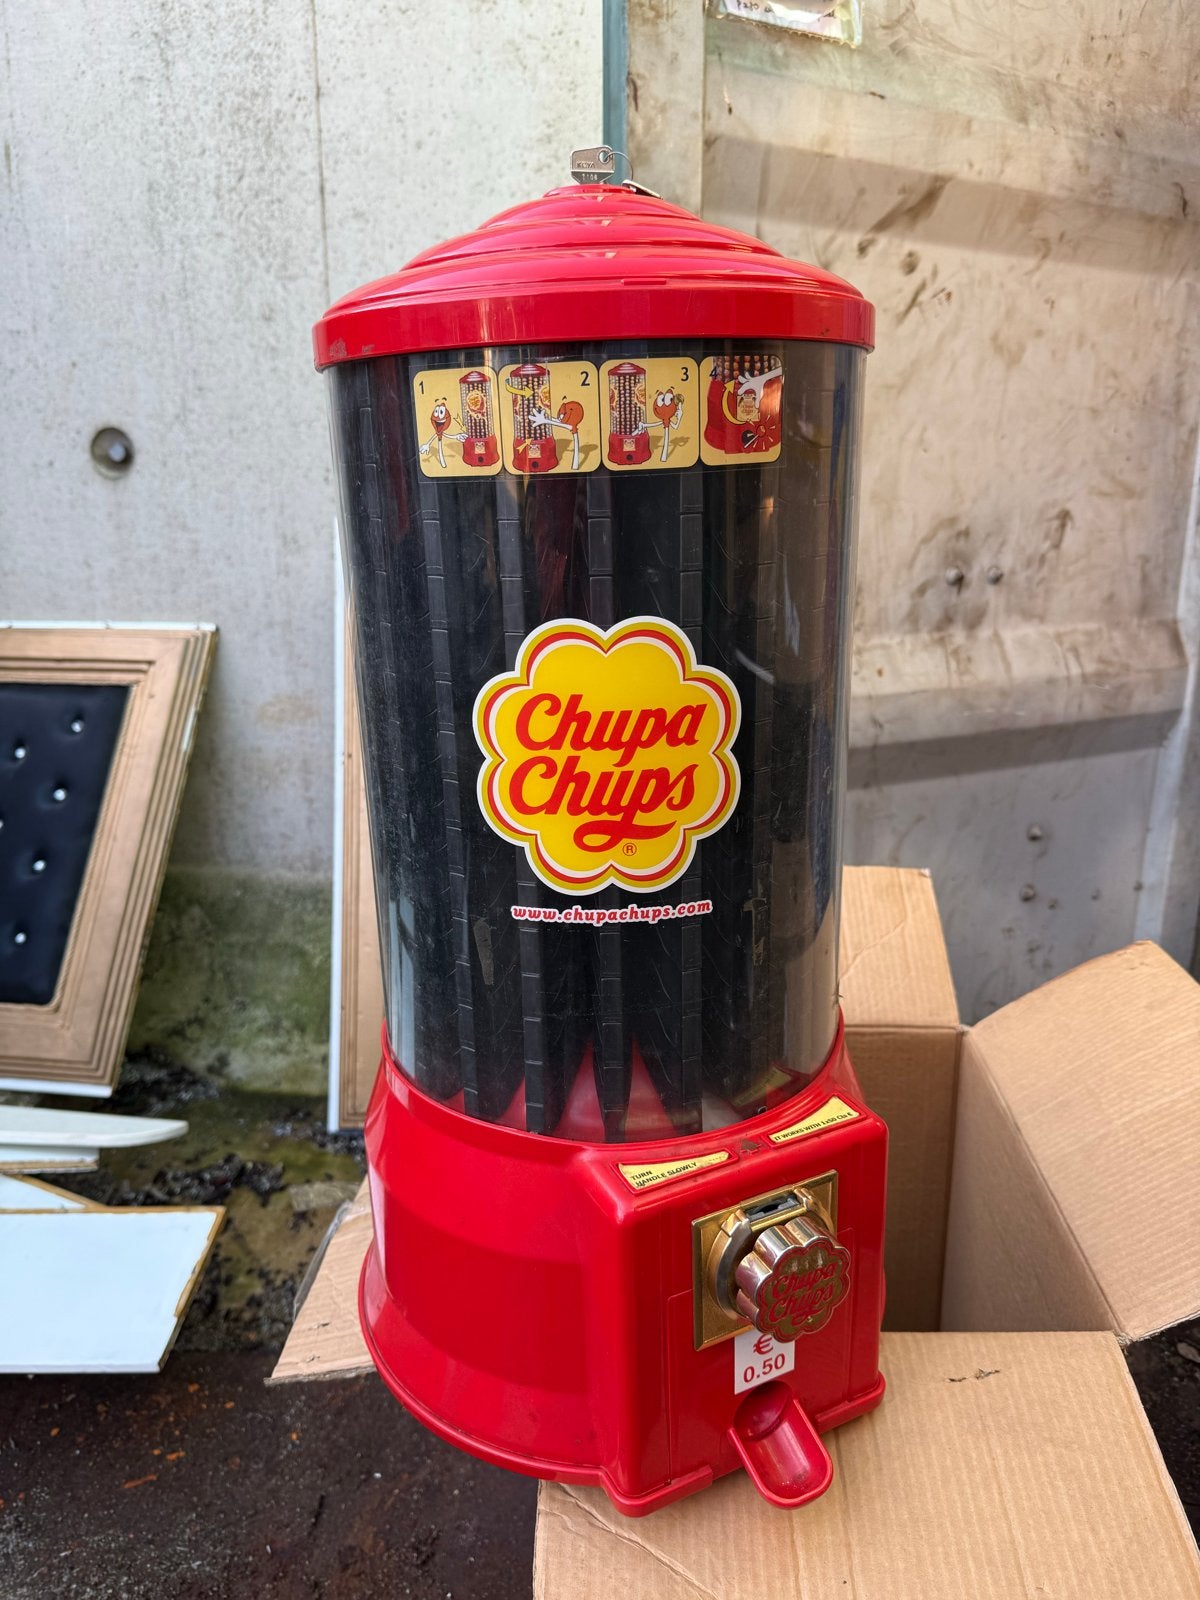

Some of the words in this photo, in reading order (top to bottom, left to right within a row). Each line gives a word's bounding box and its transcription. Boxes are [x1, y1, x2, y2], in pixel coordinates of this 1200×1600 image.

[580, 371, 591, 387] 2
[680, 367, 690, 382] 3
[708, 366, 719, 380] 4
[418, 380, 426, 395] 1
[515, 693, 708, 768] Chupa
[508, 755, 699, 853] Chups
[512, 900, 712, 926] www.chupachups.com
[630, 1170, 653, 1182] TURN
[634, 1172, 667, 1188] HANDLE
[667, 1161, 698, 1177] SLOWLY
[772, 1261, 839, 1300] Chupa
[768, 1281, 834, 1327] Chups
[753, 1333, 774, 1356] €
[743, 1353, 786, 1384] 0.50
